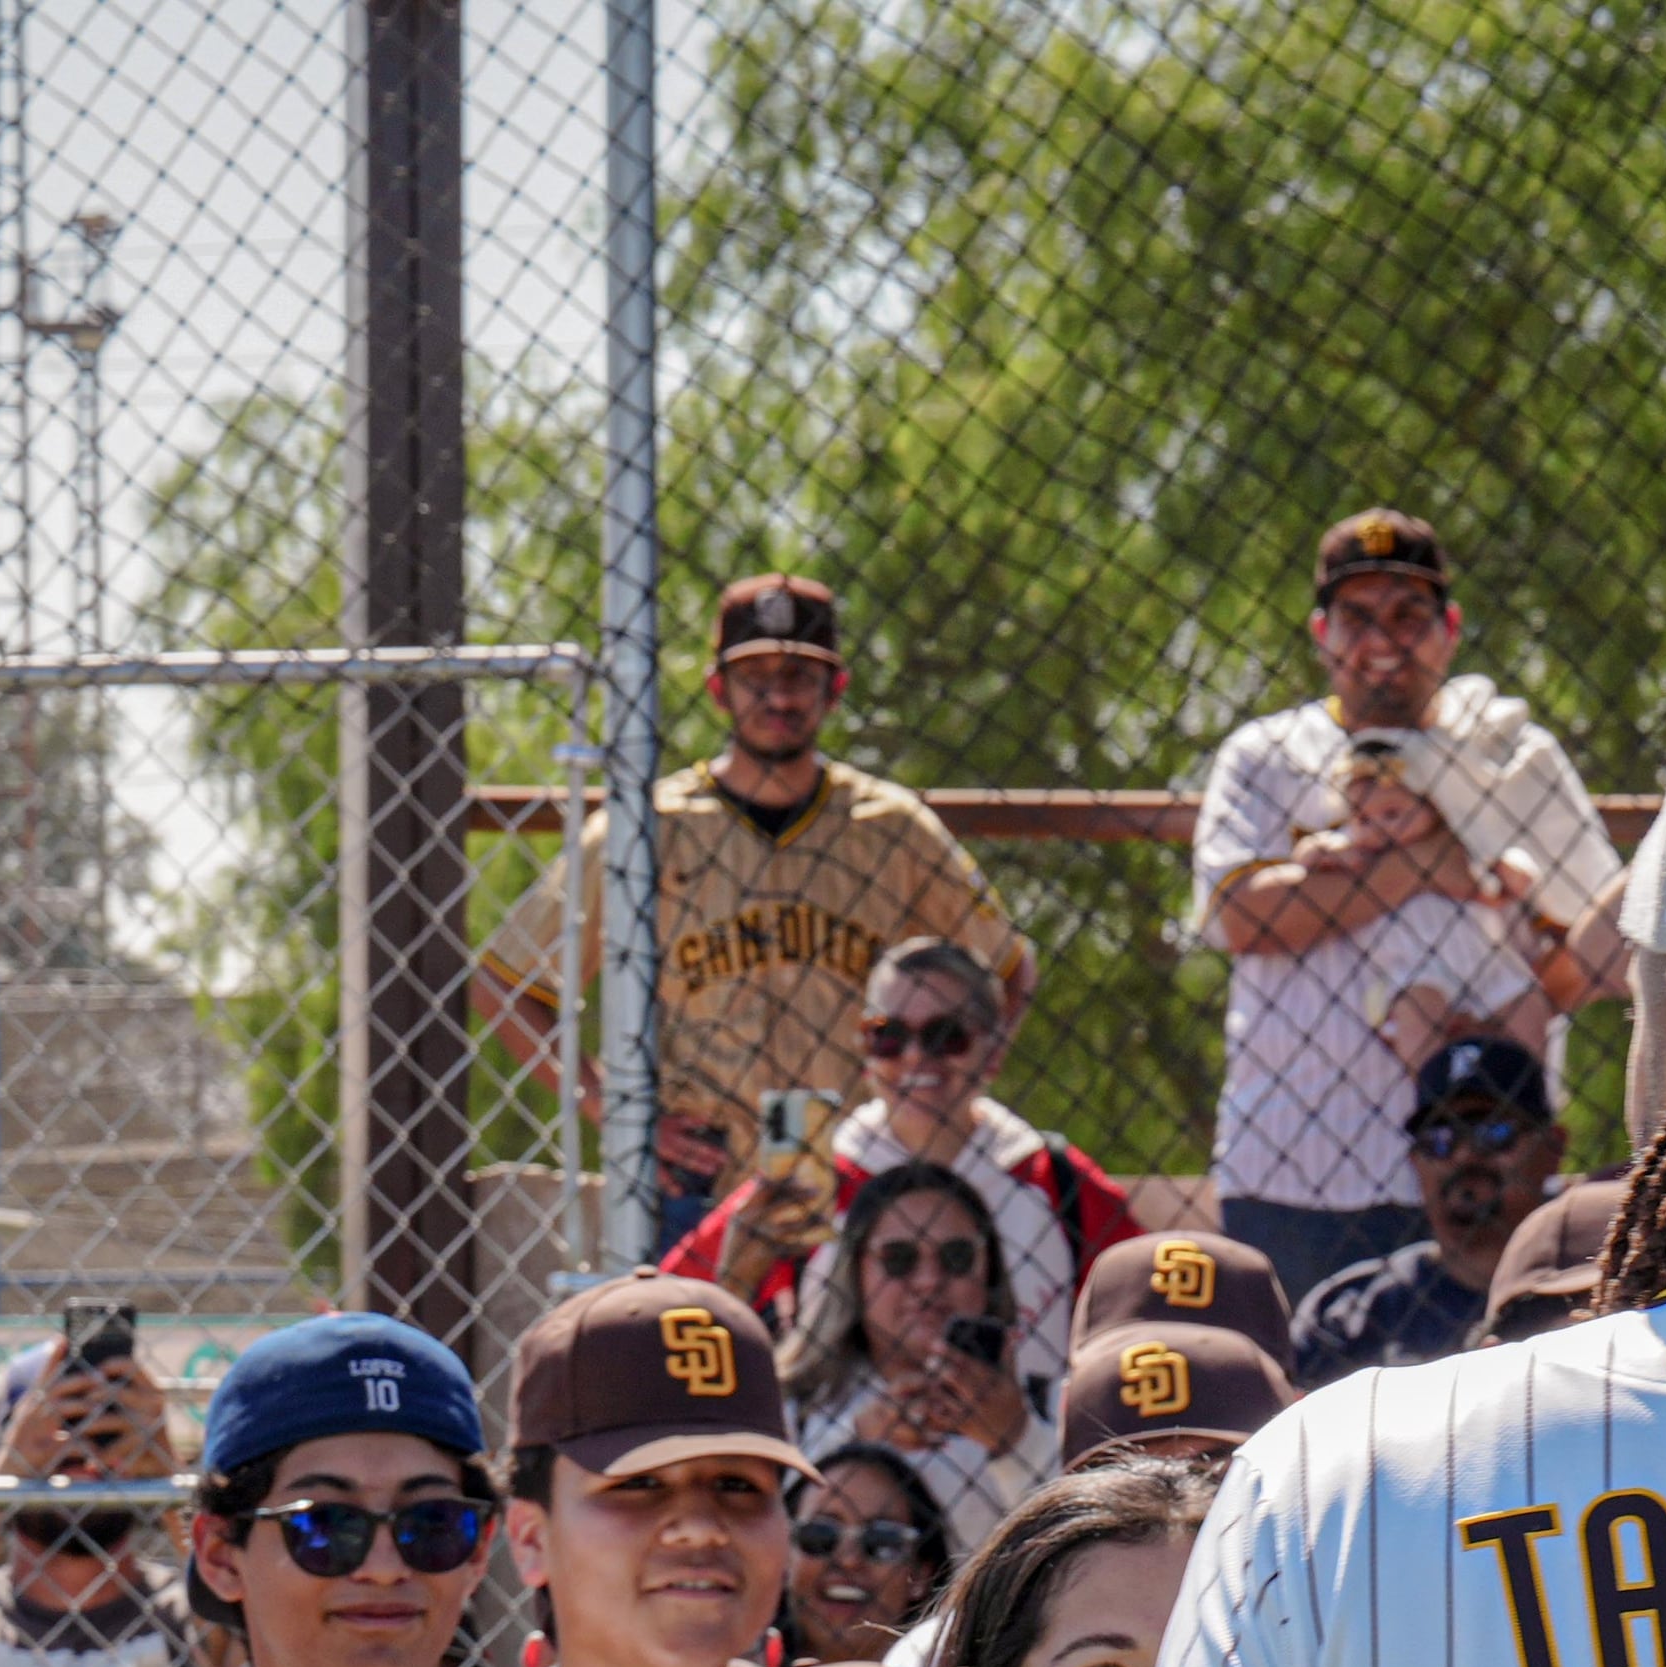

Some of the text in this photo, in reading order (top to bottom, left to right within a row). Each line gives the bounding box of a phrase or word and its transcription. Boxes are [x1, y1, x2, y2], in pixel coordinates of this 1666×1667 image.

[774, 903, 887, 982] DIEG
[1149, 1240, 1217, 1309] SD
[348, 1358, 407, 1379] LOPEZ
[660, 1308, 736, 1396] SD
[1119, 1341, 1191, 1417] SD
[364, 1378, 400, 1412] 10
